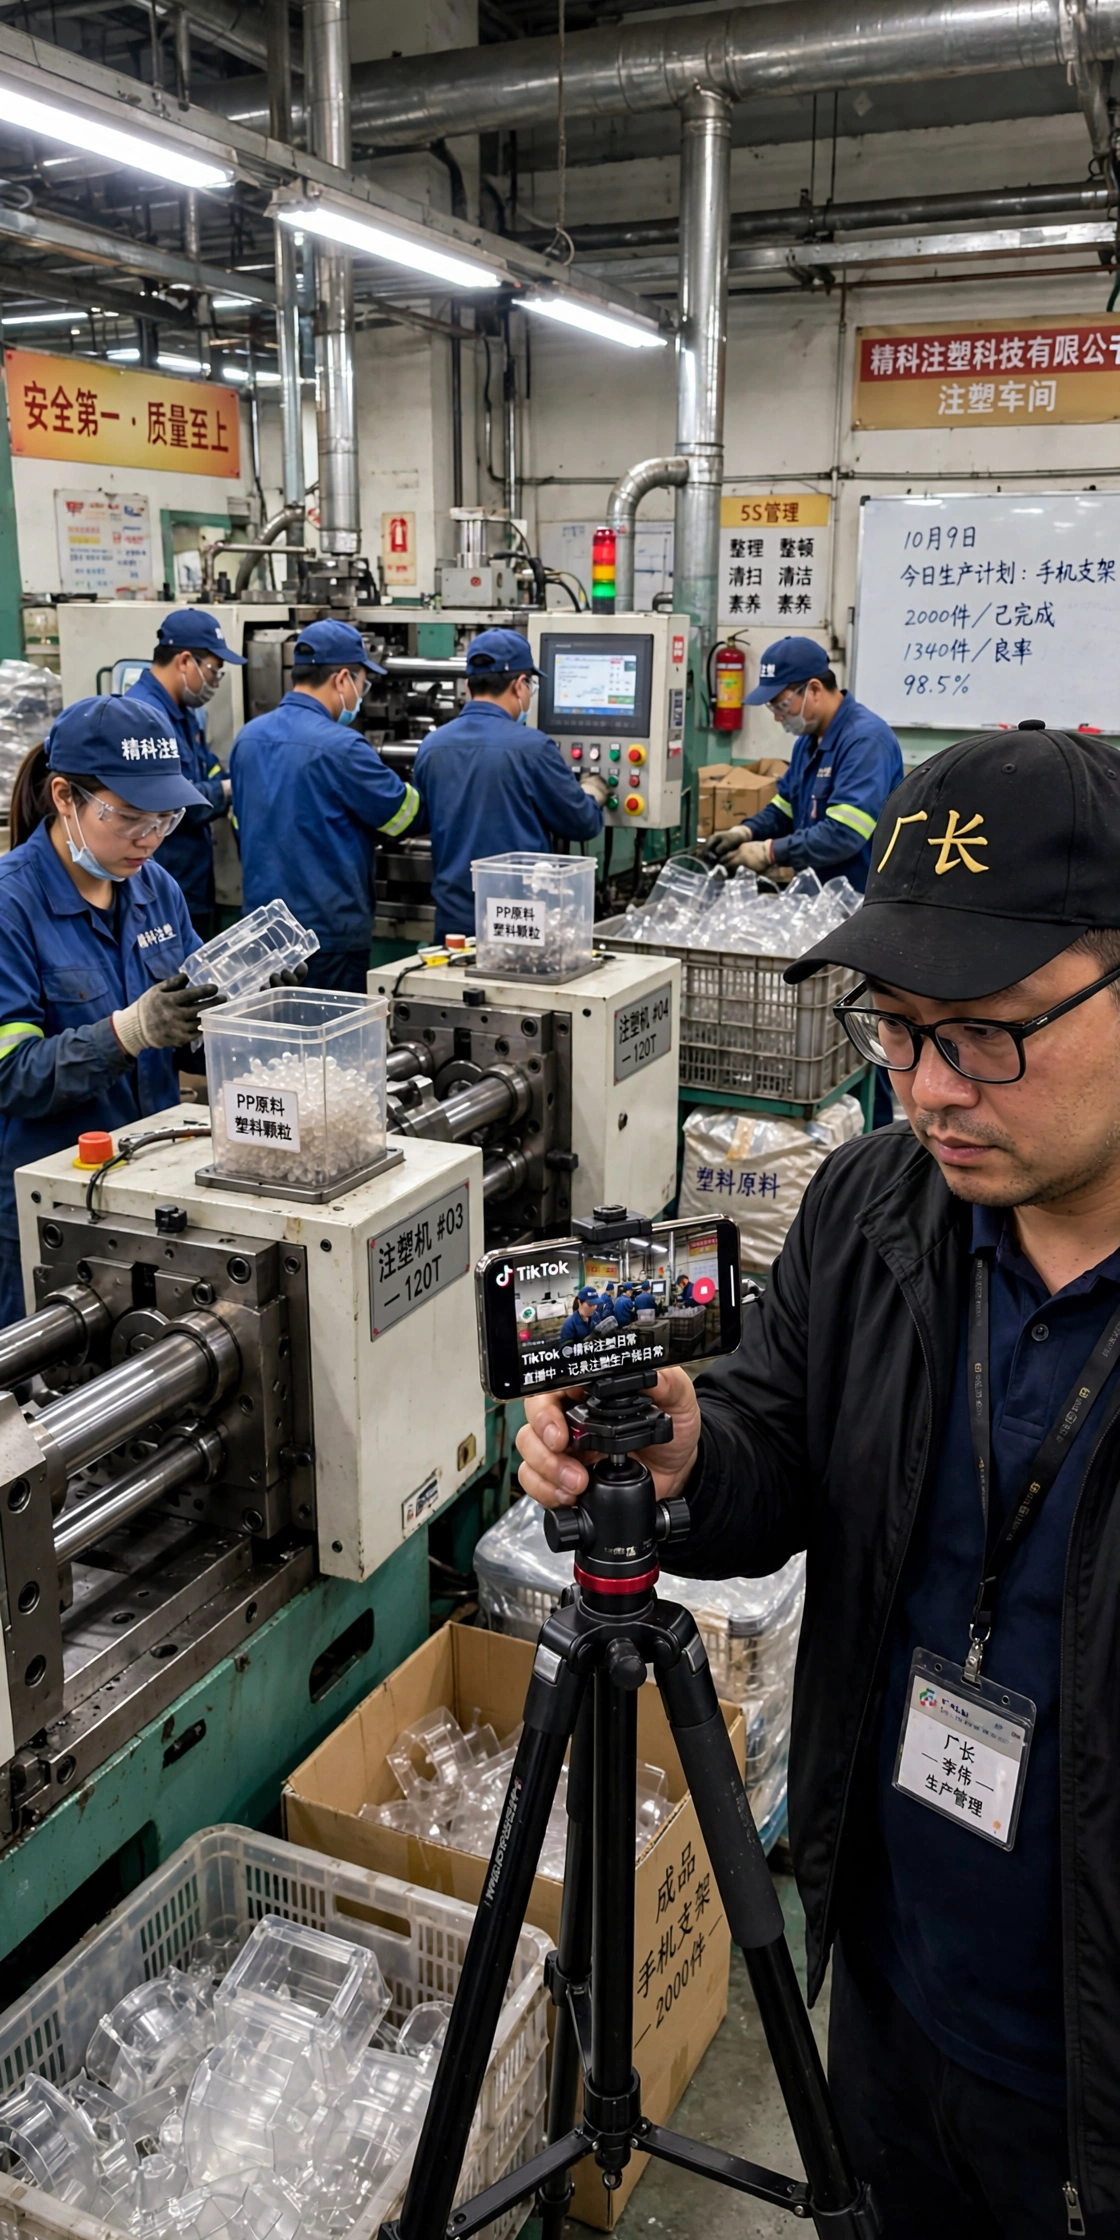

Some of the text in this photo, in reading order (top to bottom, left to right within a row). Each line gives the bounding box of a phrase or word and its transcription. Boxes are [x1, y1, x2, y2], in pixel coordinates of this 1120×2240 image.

[938, 380, 1057, 415] 注塑车间
[741, 501, 799, 523] 5S管理
[730, 537, 815, 558] 整理 整顿
[904, 526, 976, 551] 10月9日
[729, 565, 813, 587] 清扫 清洁
[729, 593, 812, 615] 素养 素养
[904, 673, 971, 696] 98.5%
[877, 810, 989, 875] 厂长
[496, 906, 535, 921] PP原料
[619, 997, 669, 1045] 注塑机 #04
[237, 1093, 285, 1117] PP原料
[235, 1116, 292, 1141] 塑料颗粒
[696, 1166, 781, 1199] 塑料原料
[378, 1202, 464, 1283] 注塑机 #03
[516, 1260, 569, 1281] TikTok
[521, 1349, 560, 1366] TikTok
[943, 1734, 976, 1764] 厂长
[924, 1773, 983, 1818] 生产管理
[655, 1840, 696, 1924] 成品
[636, 1872, 711, 1998] 手机支架
